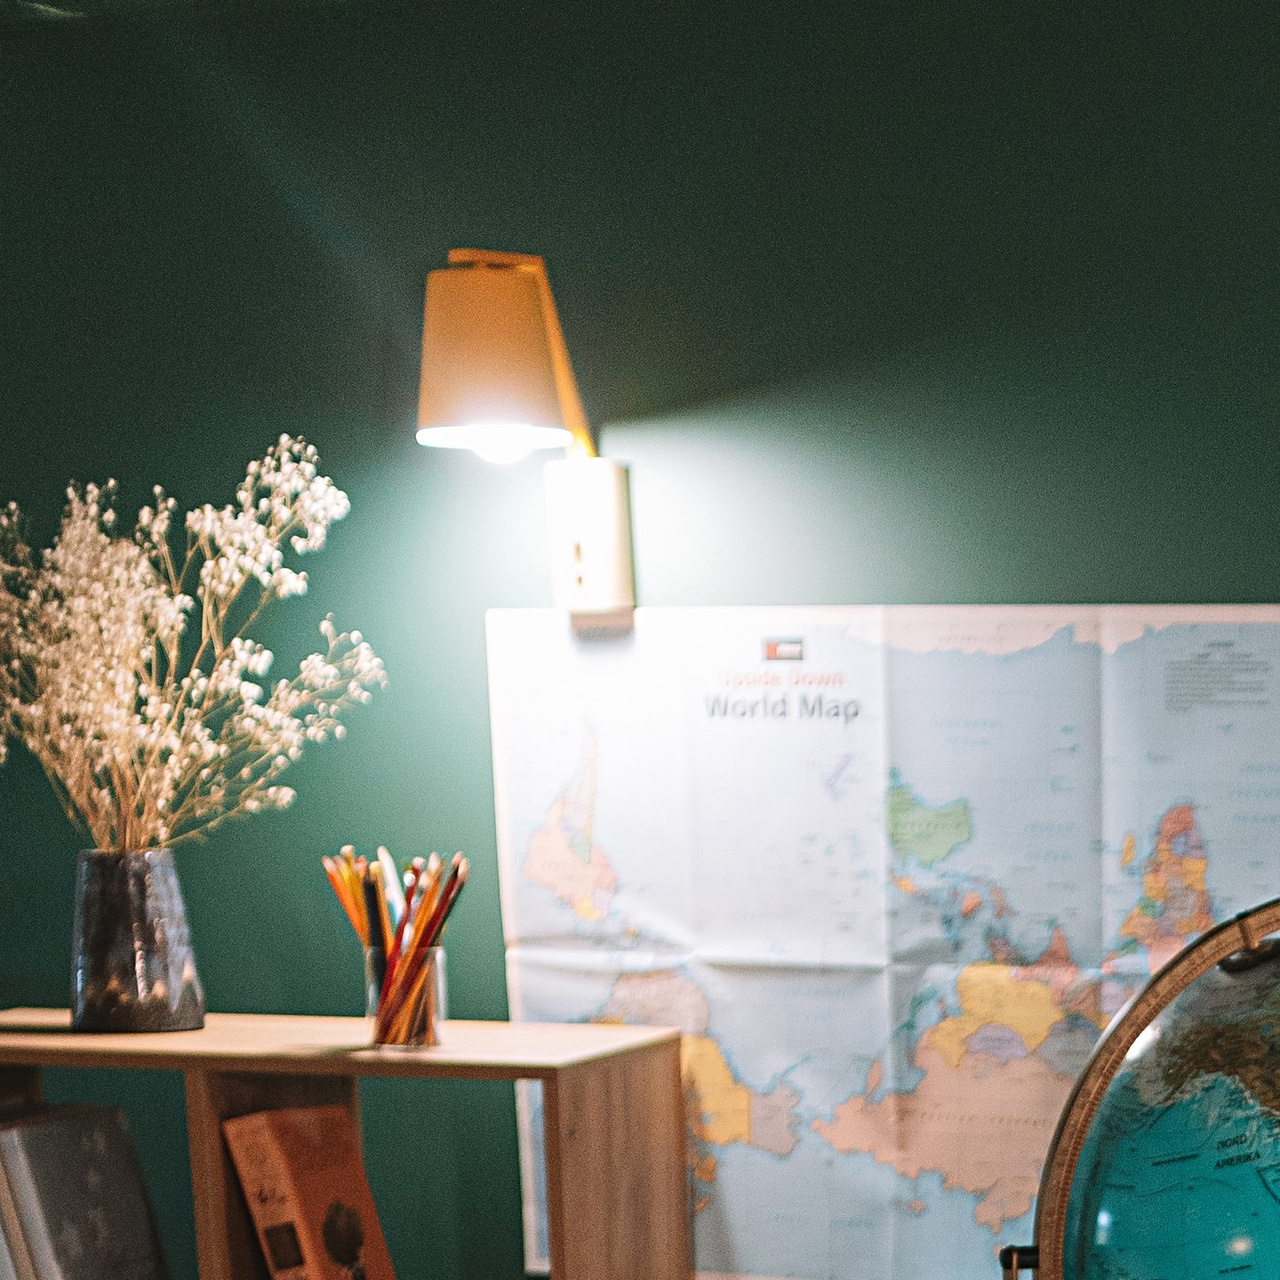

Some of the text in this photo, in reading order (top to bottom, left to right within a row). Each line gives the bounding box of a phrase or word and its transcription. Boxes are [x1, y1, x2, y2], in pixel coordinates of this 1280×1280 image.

[789, 668, 846, 687] Down
[704, 692, 861, 726] World Map
[1217, 1133, 1248, 1150] NORD
[1214, 1151, 1260, 1170] AMERIKA
